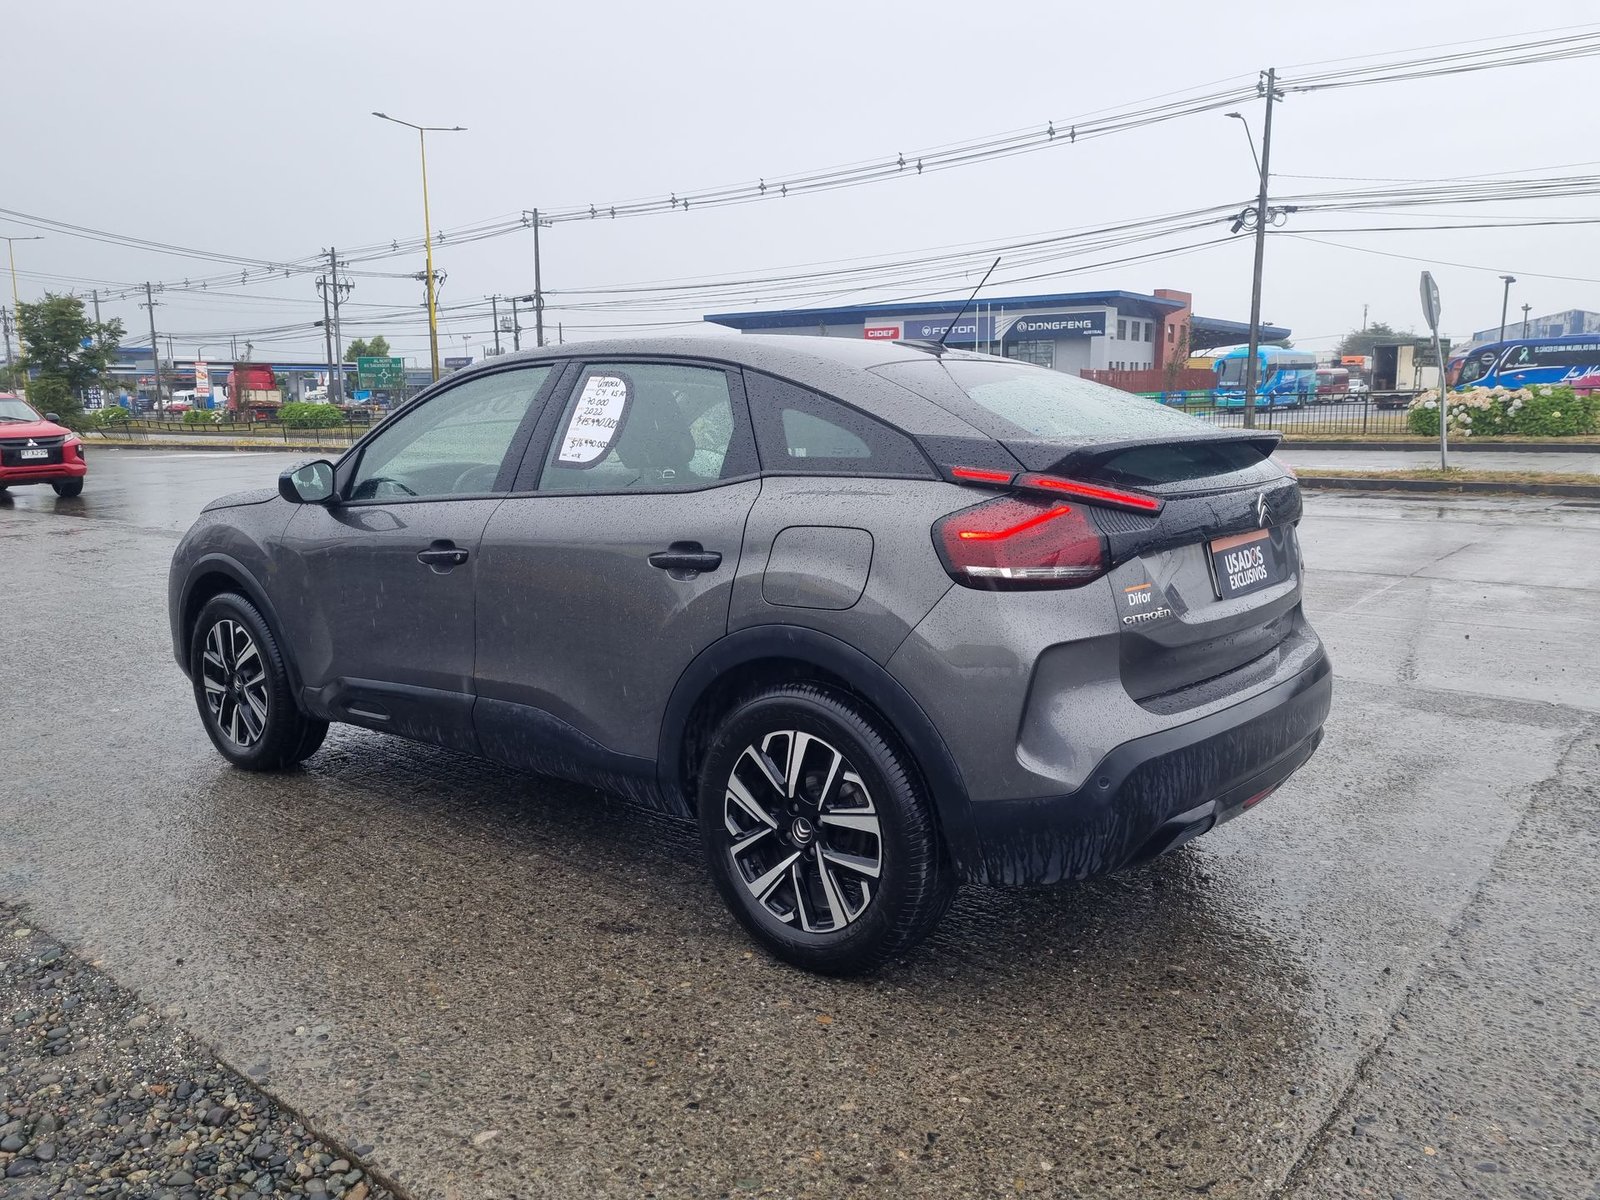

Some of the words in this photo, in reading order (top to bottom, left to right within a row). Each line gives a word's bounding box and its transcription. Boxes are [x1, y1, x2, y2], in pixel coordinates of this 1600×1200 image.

[932, 325, 976, 335] FOTON
[1028, 320, 1092, 331] DONGFENG
[868, 330, 894, 338] CIDEF
[584, 407, 603, 416] 2022
[1225, 545, 1264, 573] USADOS
[1229, 565, 1268, 590] EXCLUSIVOS
[1128, 592, 1152, 606] Difor
[1123, 607, 1171, 625] CITROËN
